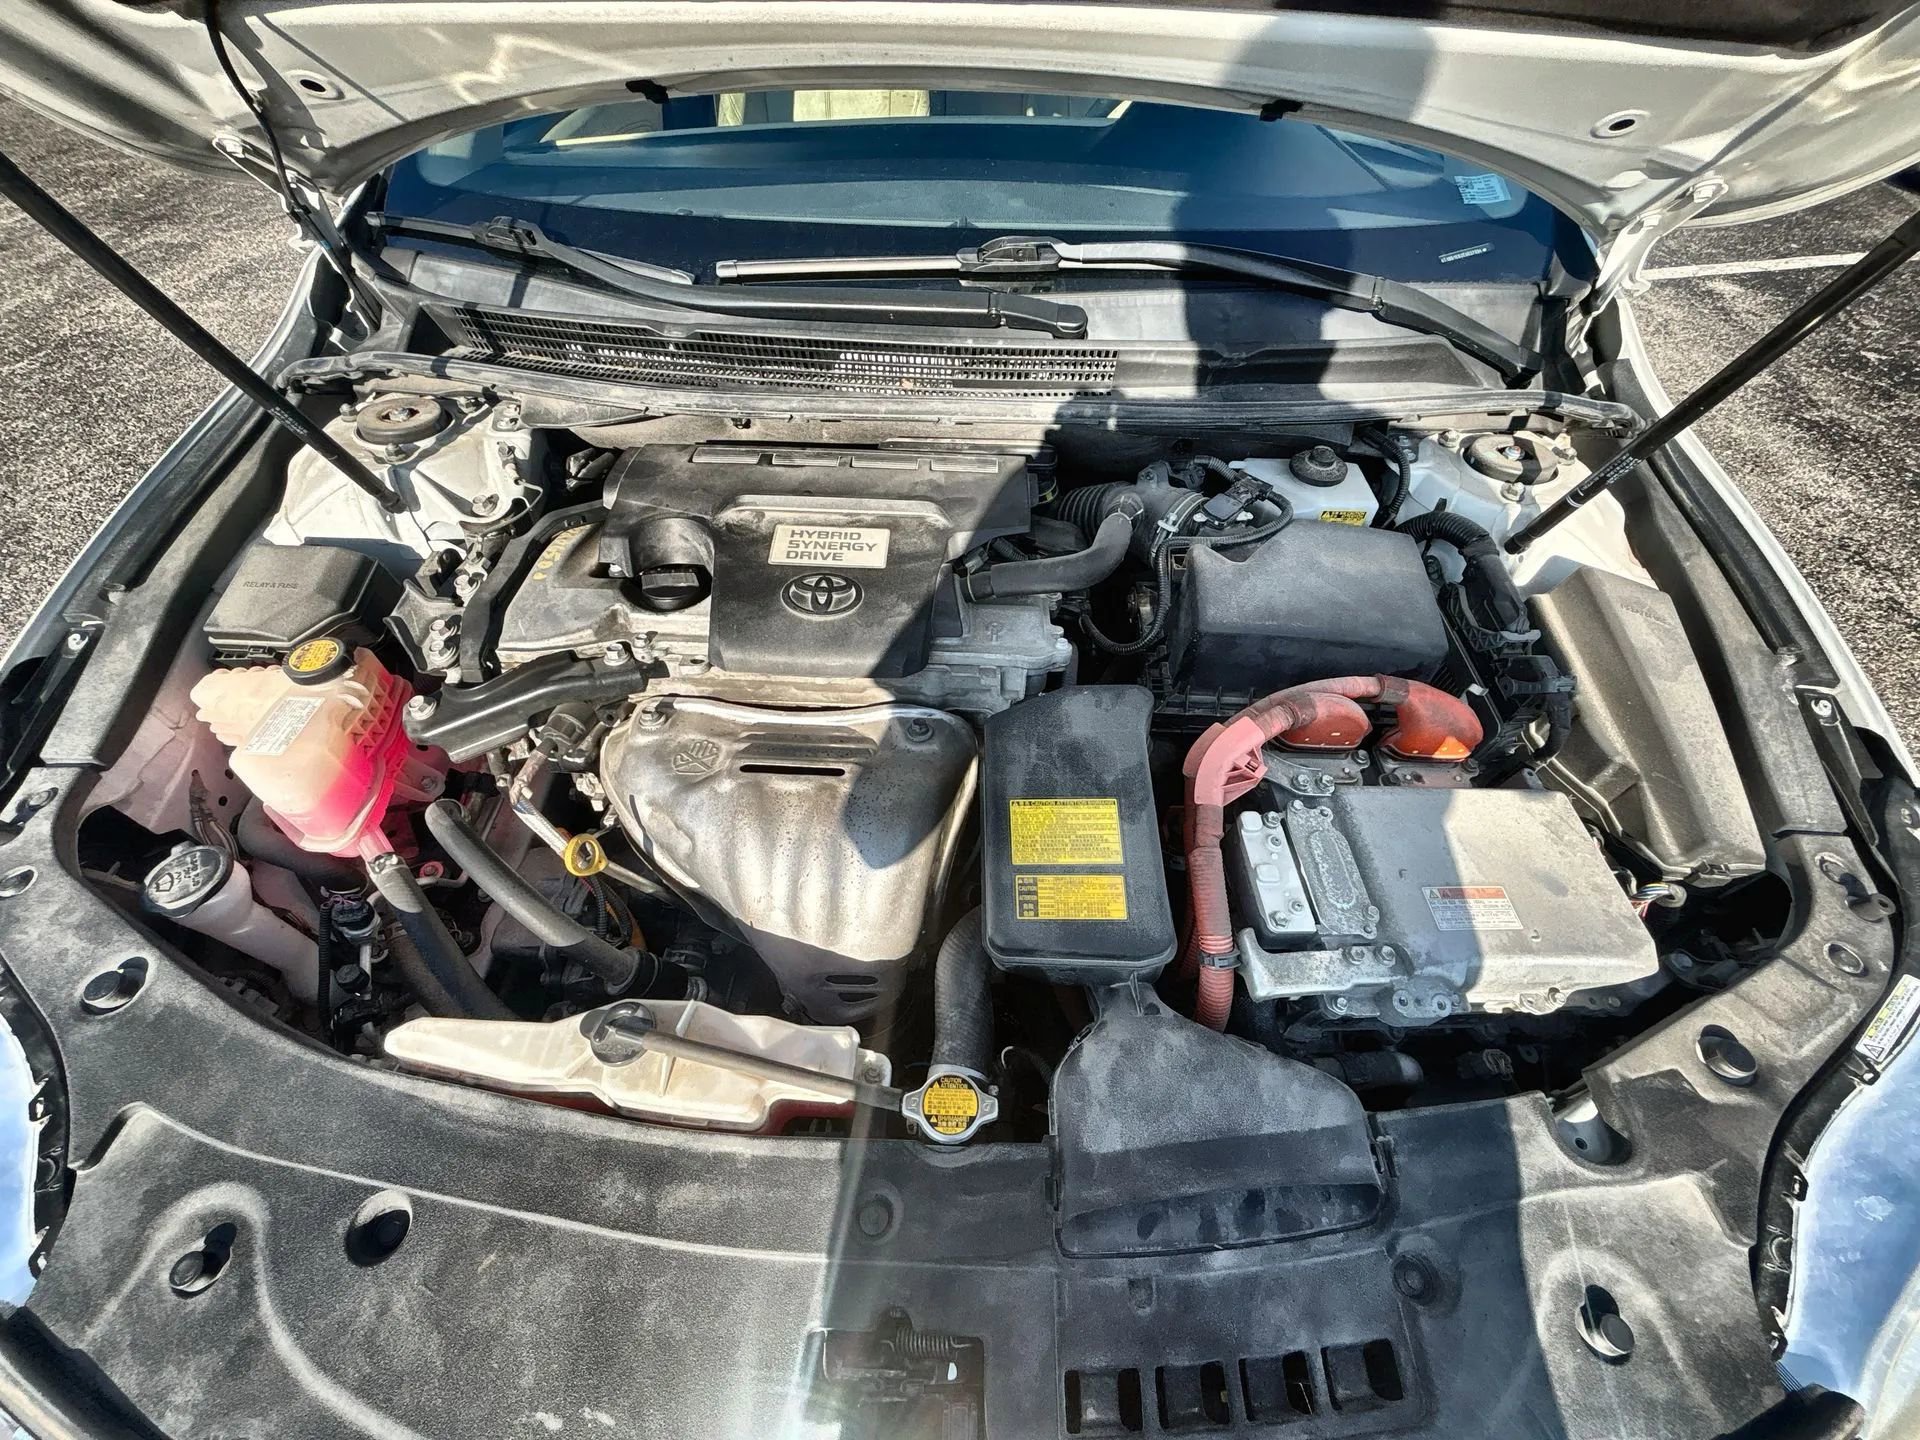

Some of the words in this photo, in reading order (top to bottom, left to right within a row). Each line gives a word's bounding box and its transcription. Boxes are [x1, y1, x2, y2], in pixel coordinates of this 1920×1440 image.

[791, 530, 861, 540] HYBRID
[788, 540, 877, 551] SYNERGY
[786, 551, 843, 561] DRIVE
